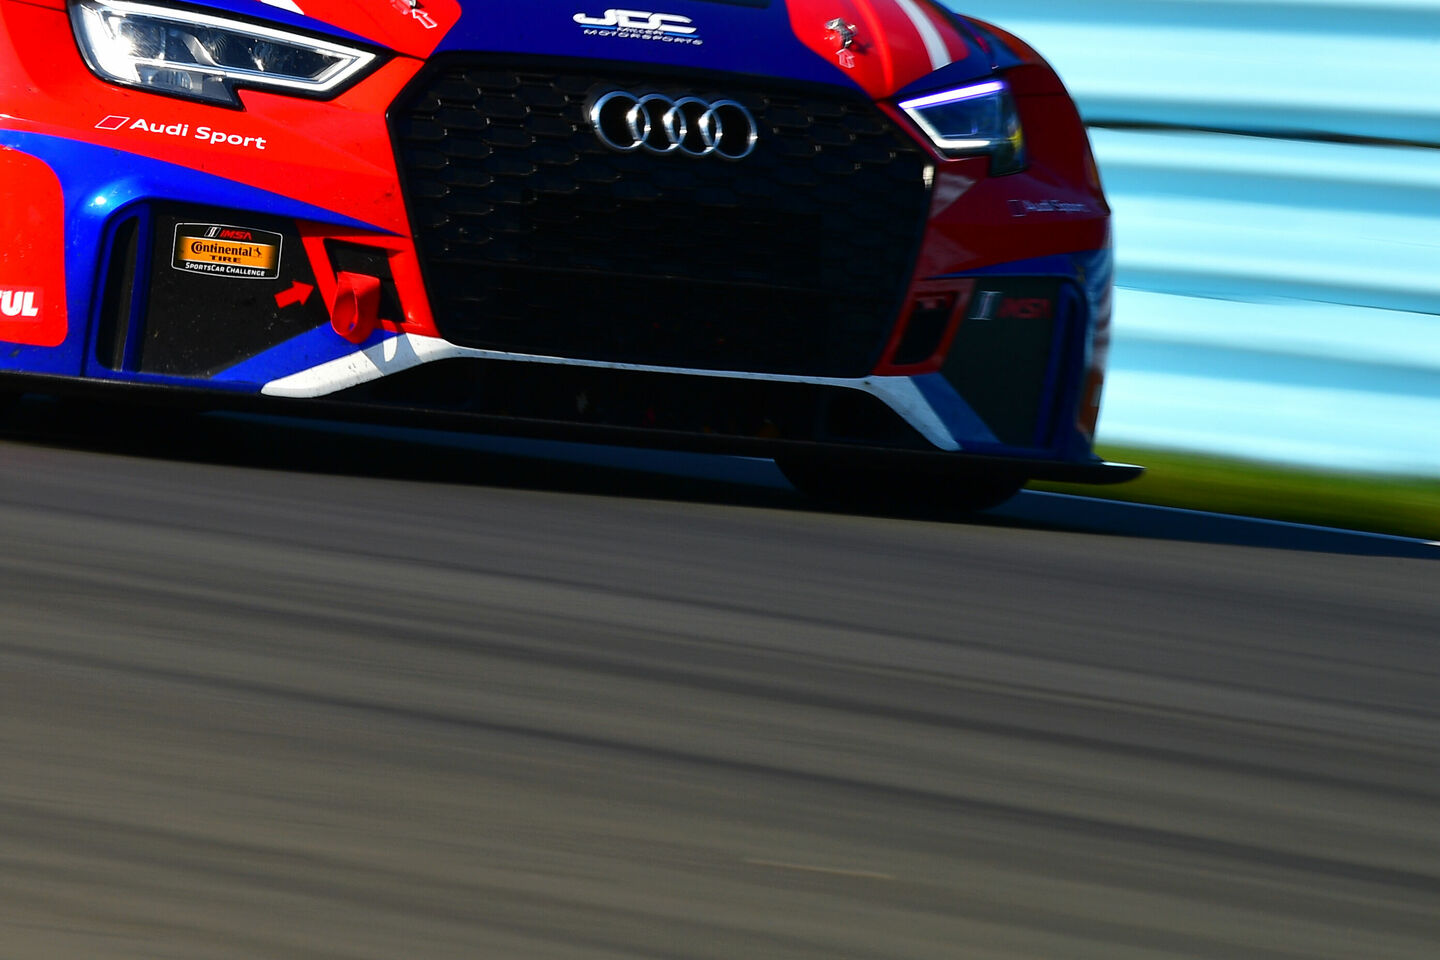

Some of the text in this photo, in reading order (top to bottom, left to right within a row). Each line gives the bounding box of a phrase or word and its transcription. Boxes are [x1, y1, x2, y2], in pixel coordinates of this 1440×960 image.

[584, 29, 703, 45] MOTORSPORTS
[129, 118, 266, 149] Audi Sport
[220, 229, 252, 240] IMSA
[191, 241, 252, 257] Continental
[209, 254, 241, 263] TIRE
